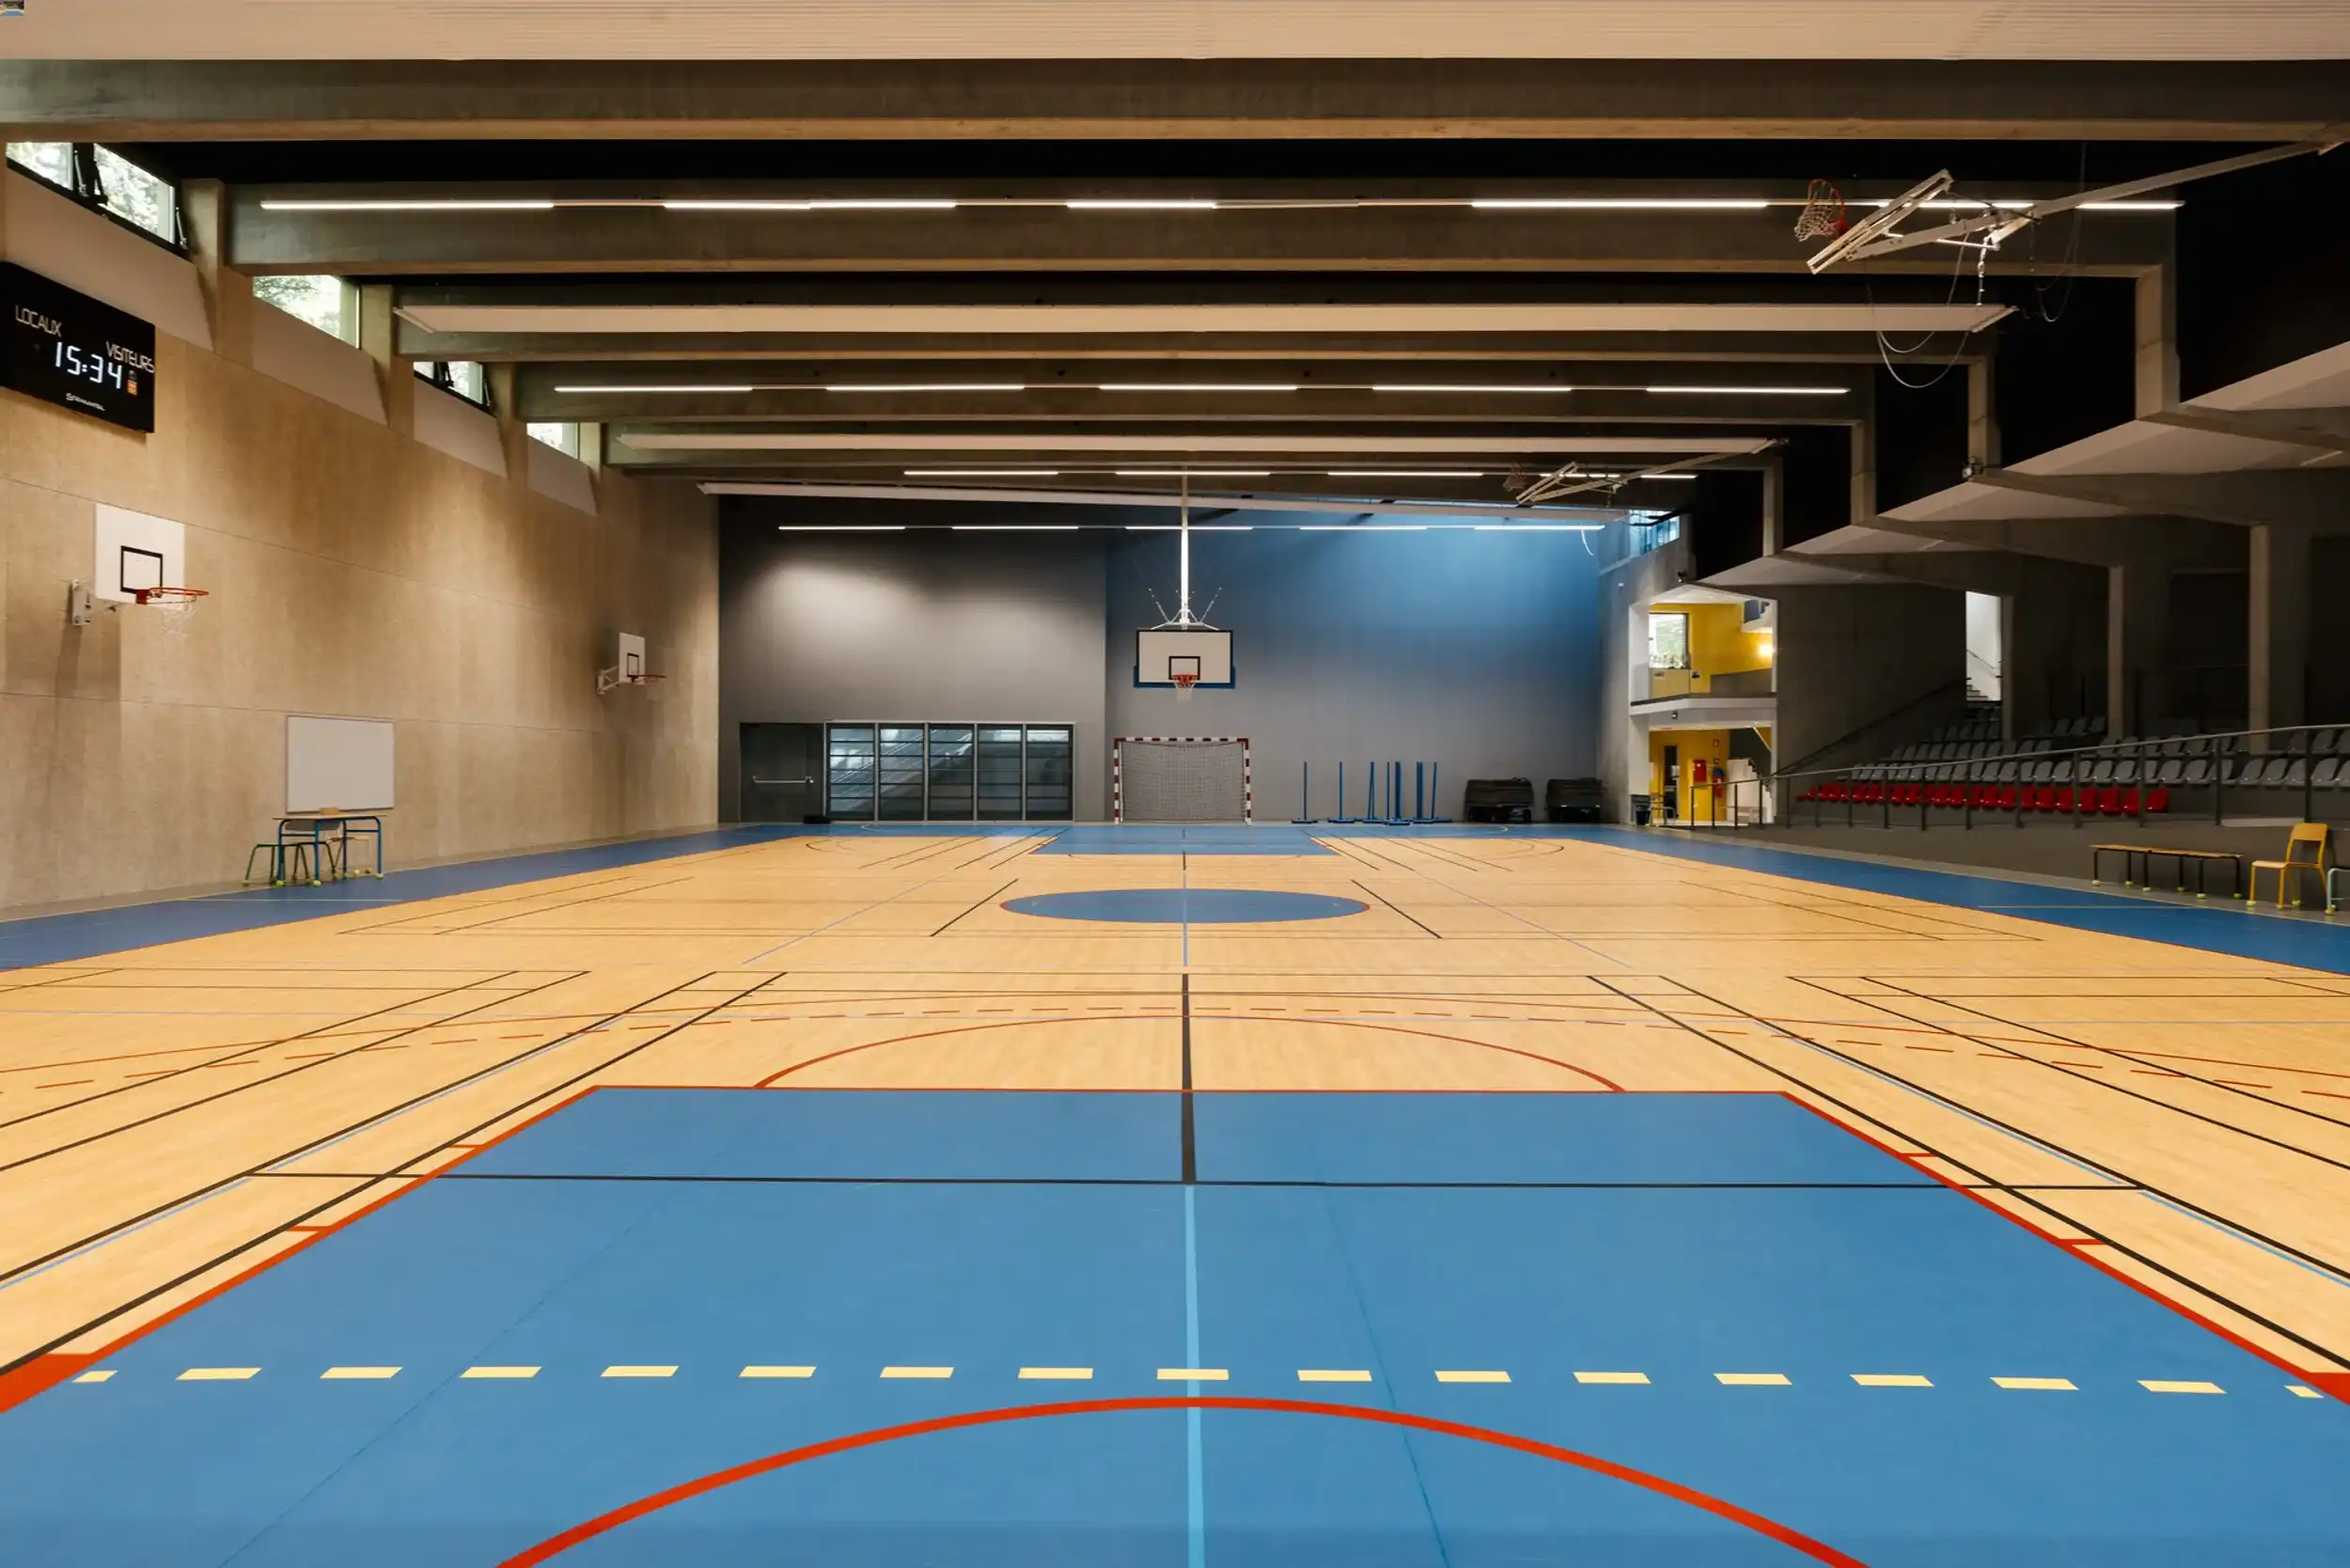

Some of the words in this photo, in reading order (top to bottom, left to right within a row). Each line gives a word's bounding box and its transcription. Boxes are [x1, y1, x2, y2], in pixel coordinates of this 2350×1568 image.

[15, 305, 62, 337] LOCAUX
[55, 341, 123, 389] 15:34
[105, 341, 154, 373] VISITEURS
